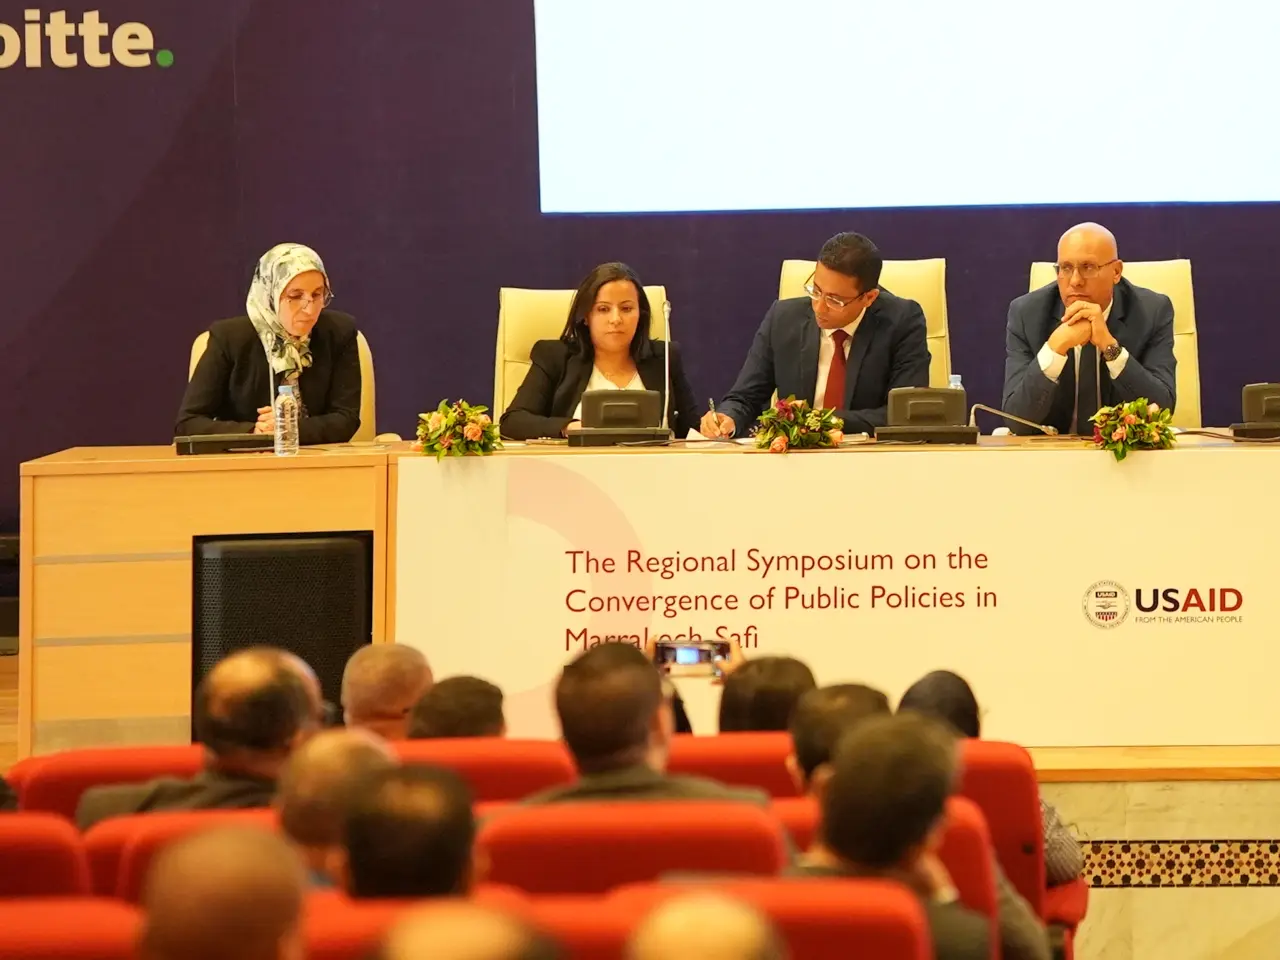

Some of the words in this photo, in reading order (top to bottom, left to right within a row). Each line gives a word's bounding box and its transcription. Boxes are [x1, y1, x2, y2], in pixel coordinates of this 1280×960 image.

[565, 551, 615, 573] The
[628, 549, 735, 579] Regional
[748, 548, 892, 578] Symposium
[905, 554, 935, 569] on
[948, 547, 987, 569] the
[566, 589, 738, 618] Convergence
[750, 587, 775, 609] of
[786, 586, 859, 609] Public
[872, 586, 965, 608] Policies
[977, 586, 996, 607] in
[1136, 588, 1242, 612] USAID
[1135, 616, 1156, 624] FROM
[1159, 616, 1173, 624] THE
